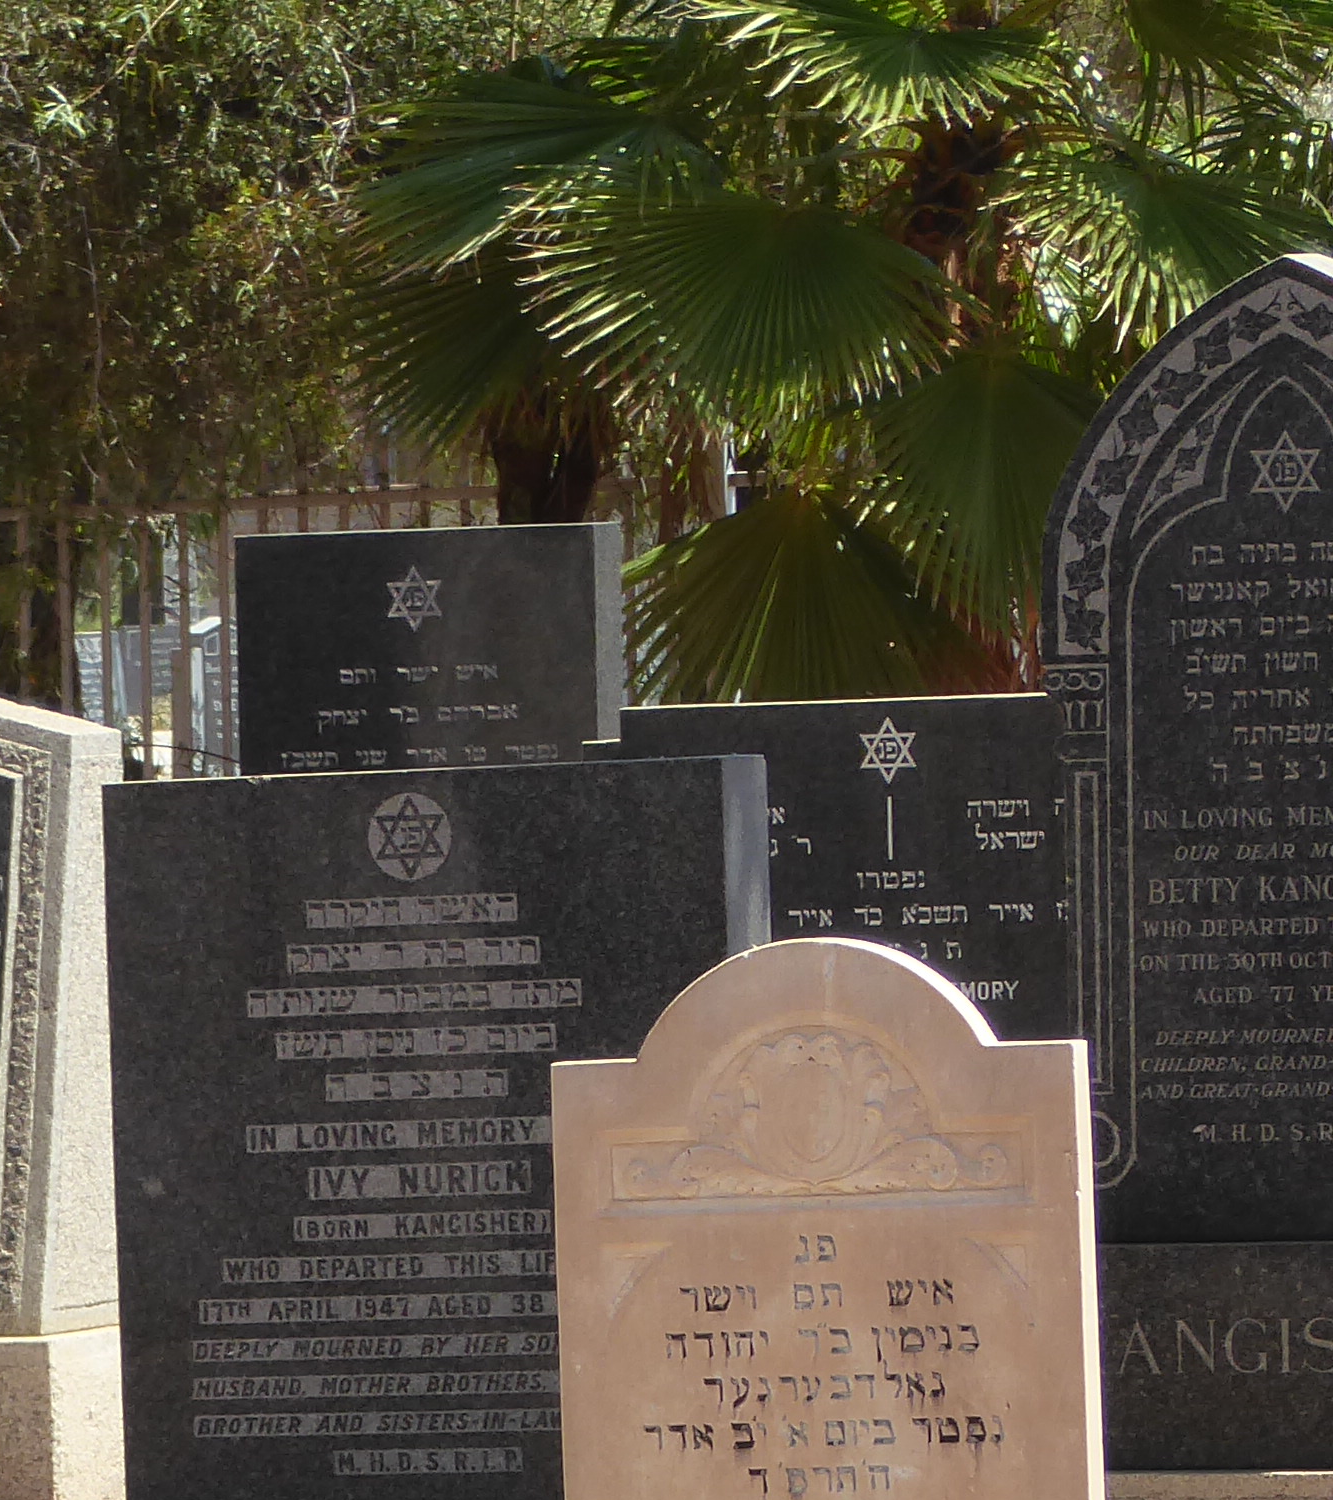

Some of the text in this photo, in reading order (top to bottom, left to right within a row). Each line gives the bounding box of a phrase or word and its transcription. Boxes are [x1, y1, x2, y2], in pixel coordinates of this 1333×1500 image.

[1142, 807, 1272, 830] IN LOVING
[1174, 844, 1295, 861] OUR DEAR
[1147, 877, 1244, 905] BETTY
[1143, 917, 1318, 938] WHO DEPARTED
[1140, 954, 1219, 971] ON THE
[1194, 985, 1295, 1005] AGED 77
[1155, 1029, 1234, 1046] DEEPLY
[1142, 1082, 1184, 1100] AND
[249, 1120, 535, 1151] IN LOVING MEMORY
[313, 1162, 529, 1197] IVY NURICK
[225, 1254, 500, 1280] WHO DEPARTED THIS
[887, 1278, 955, 1307] איש
[267, 1298, 339, 1320] APRIL
[355, 1297, 410, 1318] 1947
[427, 1296, 492, 1316] AGED
[512, 1294, 544, 1314] 38
[193, 1334, 508, 1361] DEEPLY MOURNED BY HER
[197, 1414, 363, 1435] BROTHER AND
